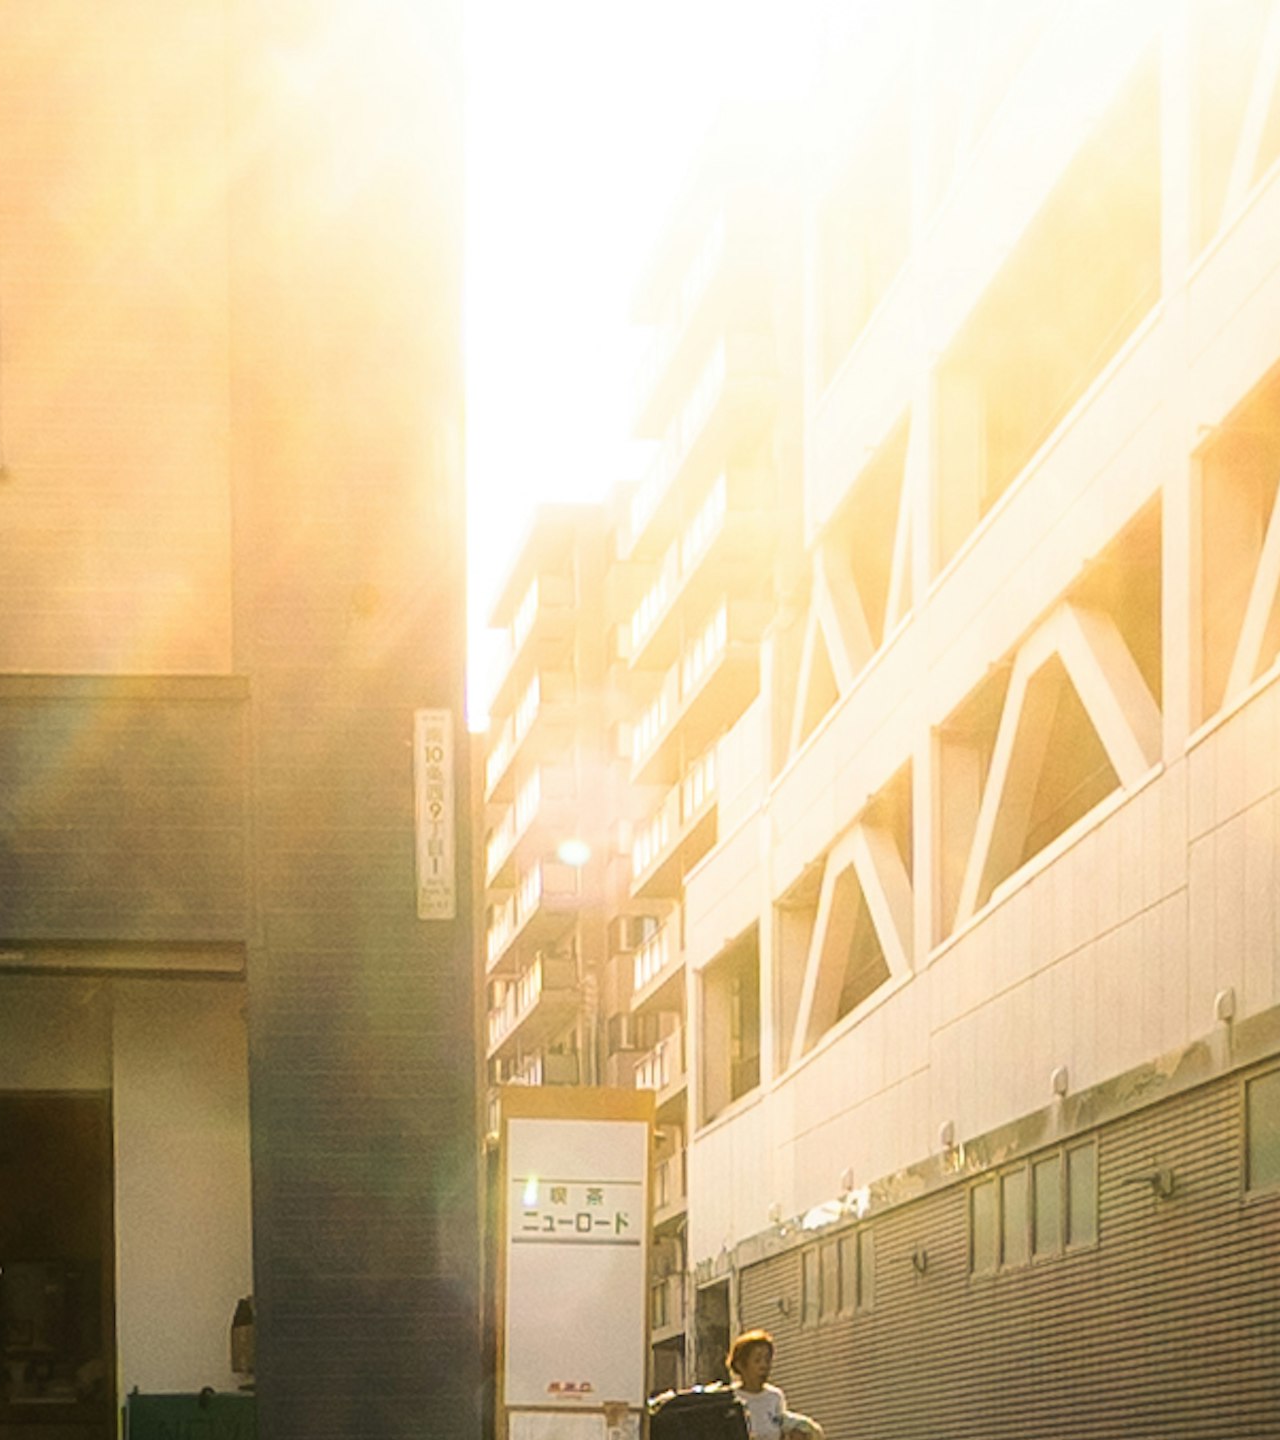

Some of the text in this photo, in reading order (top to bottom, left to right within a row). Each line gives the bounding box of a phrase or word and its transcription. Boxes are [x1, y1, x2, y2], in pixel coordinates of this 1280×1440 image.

[550, 1187, 604, 1205] 喫茶
[522, 1211, 629, 1235] ニューロード
